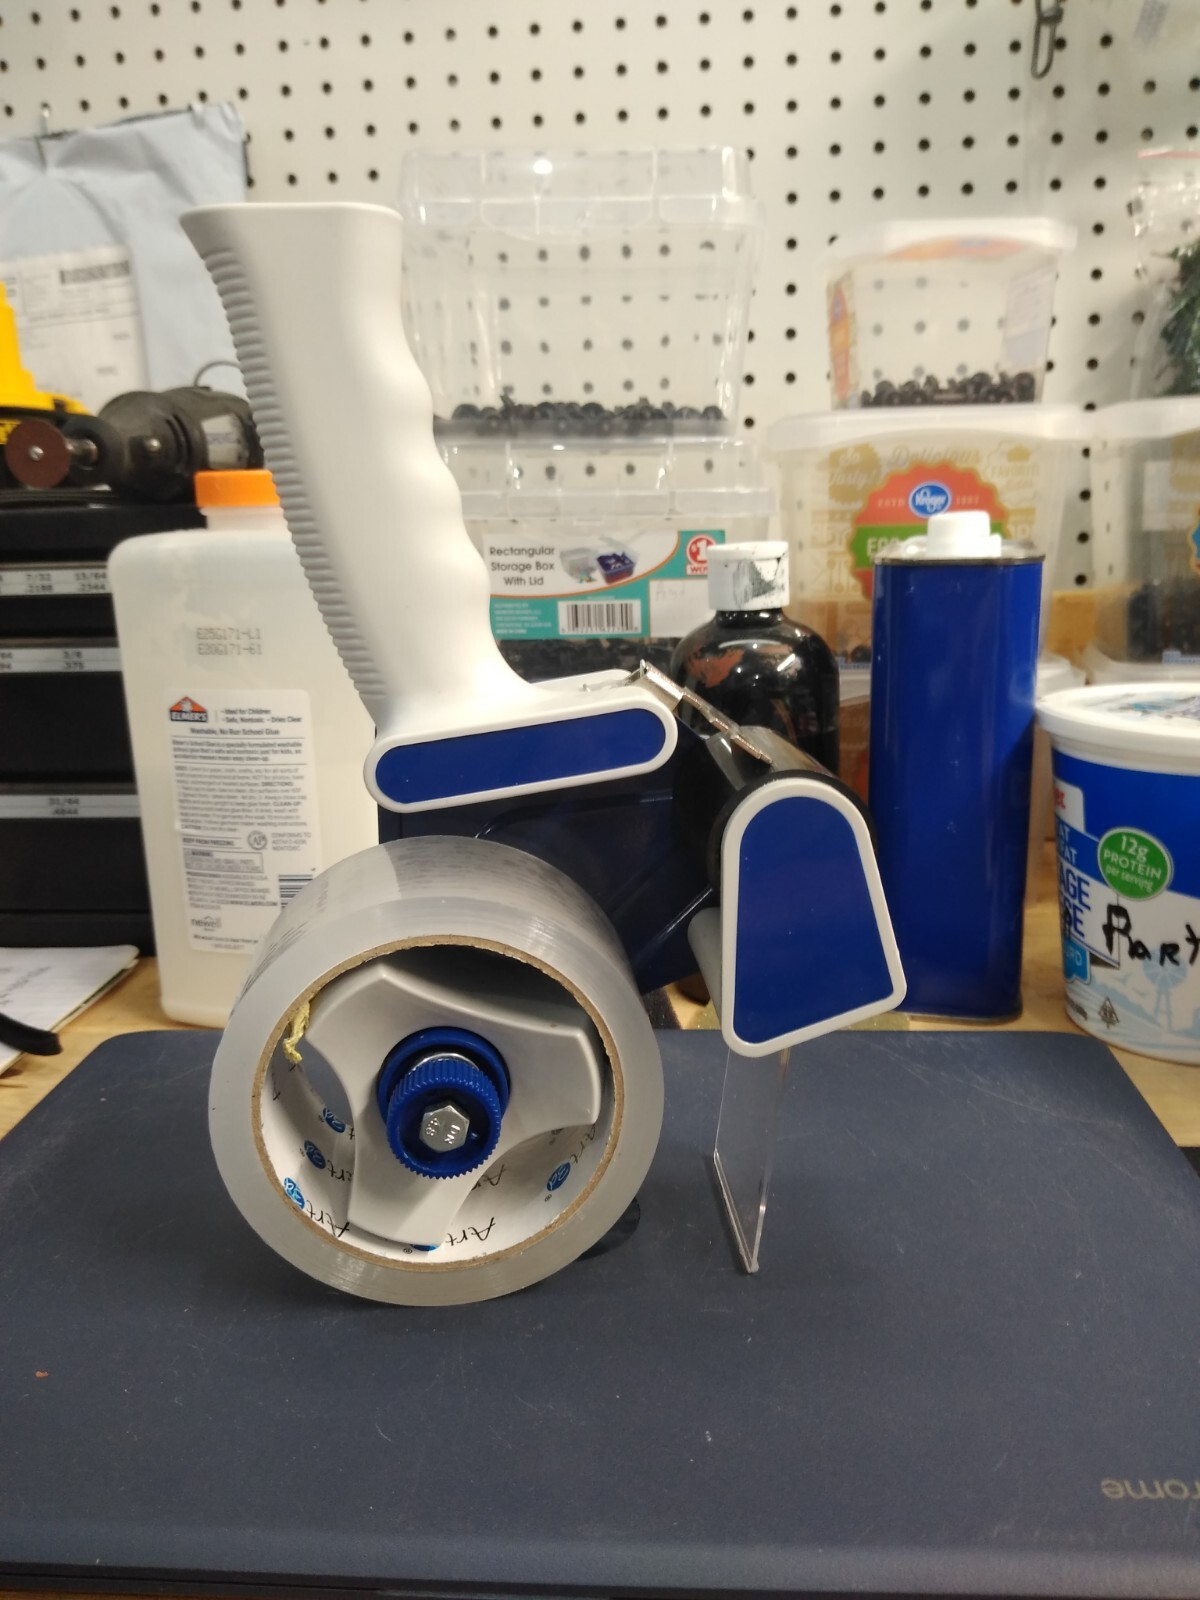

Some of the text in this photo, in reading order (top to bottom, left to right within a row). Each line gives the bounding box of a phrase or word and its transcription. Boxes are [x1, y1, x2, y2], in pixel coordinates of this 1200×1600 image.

[915, 487, 947, 513] Kroger
[489, 546, 556, 557] Rectangular
[491, 561, 555, 573] Storage Box
[503, 575, 544, 586] With Lid
[242, 728, 264, 736] School
[265, 728, 280, 736] Glue
[1121, 834, 1149, 864] 12g
[1103, 848, 1162, 879] PROTEIN
[1105, 864, 1120, 878] per
